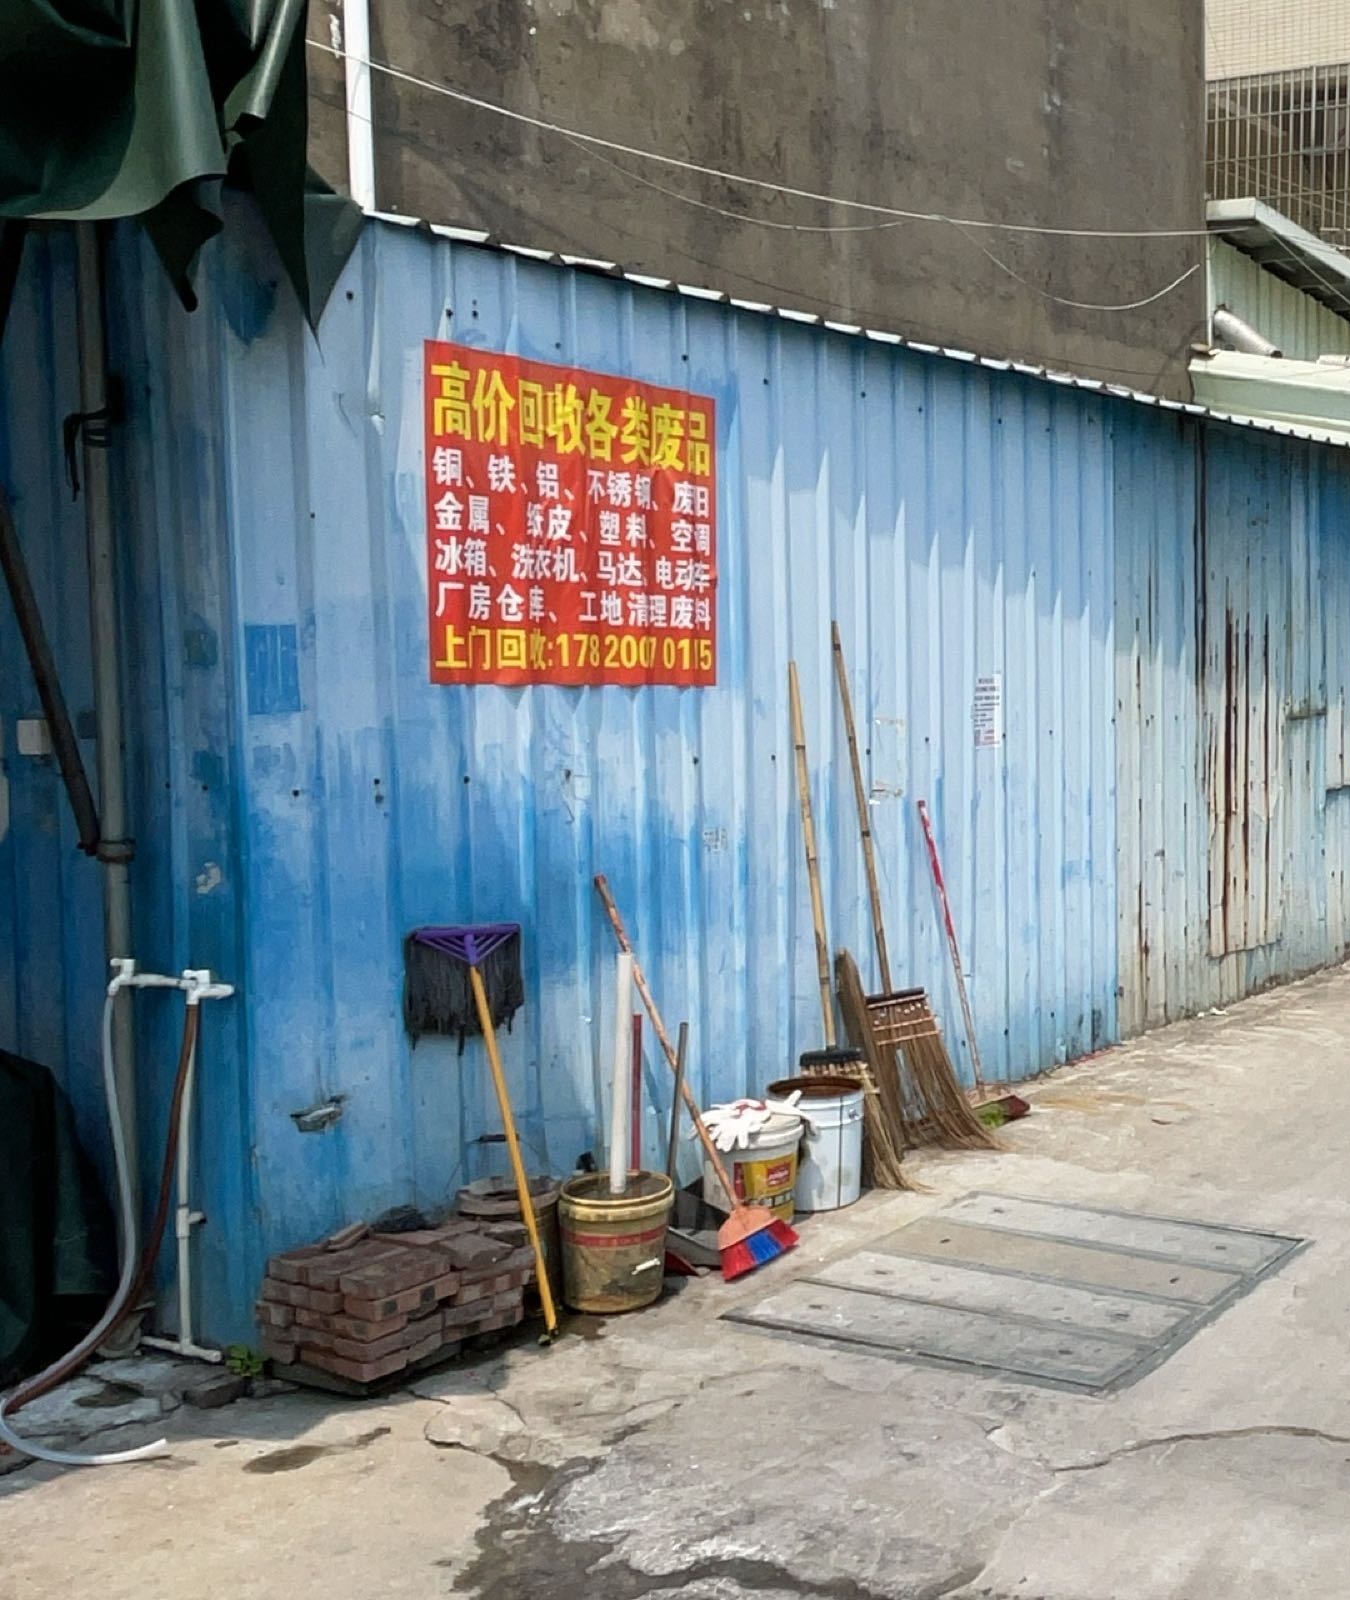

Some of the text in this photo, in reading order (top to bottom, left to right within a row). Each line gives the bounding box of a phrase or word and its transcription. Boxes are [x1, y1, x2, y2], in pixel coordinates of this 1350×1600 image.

[431, 361, 710, 476] 高价回收各类废品
